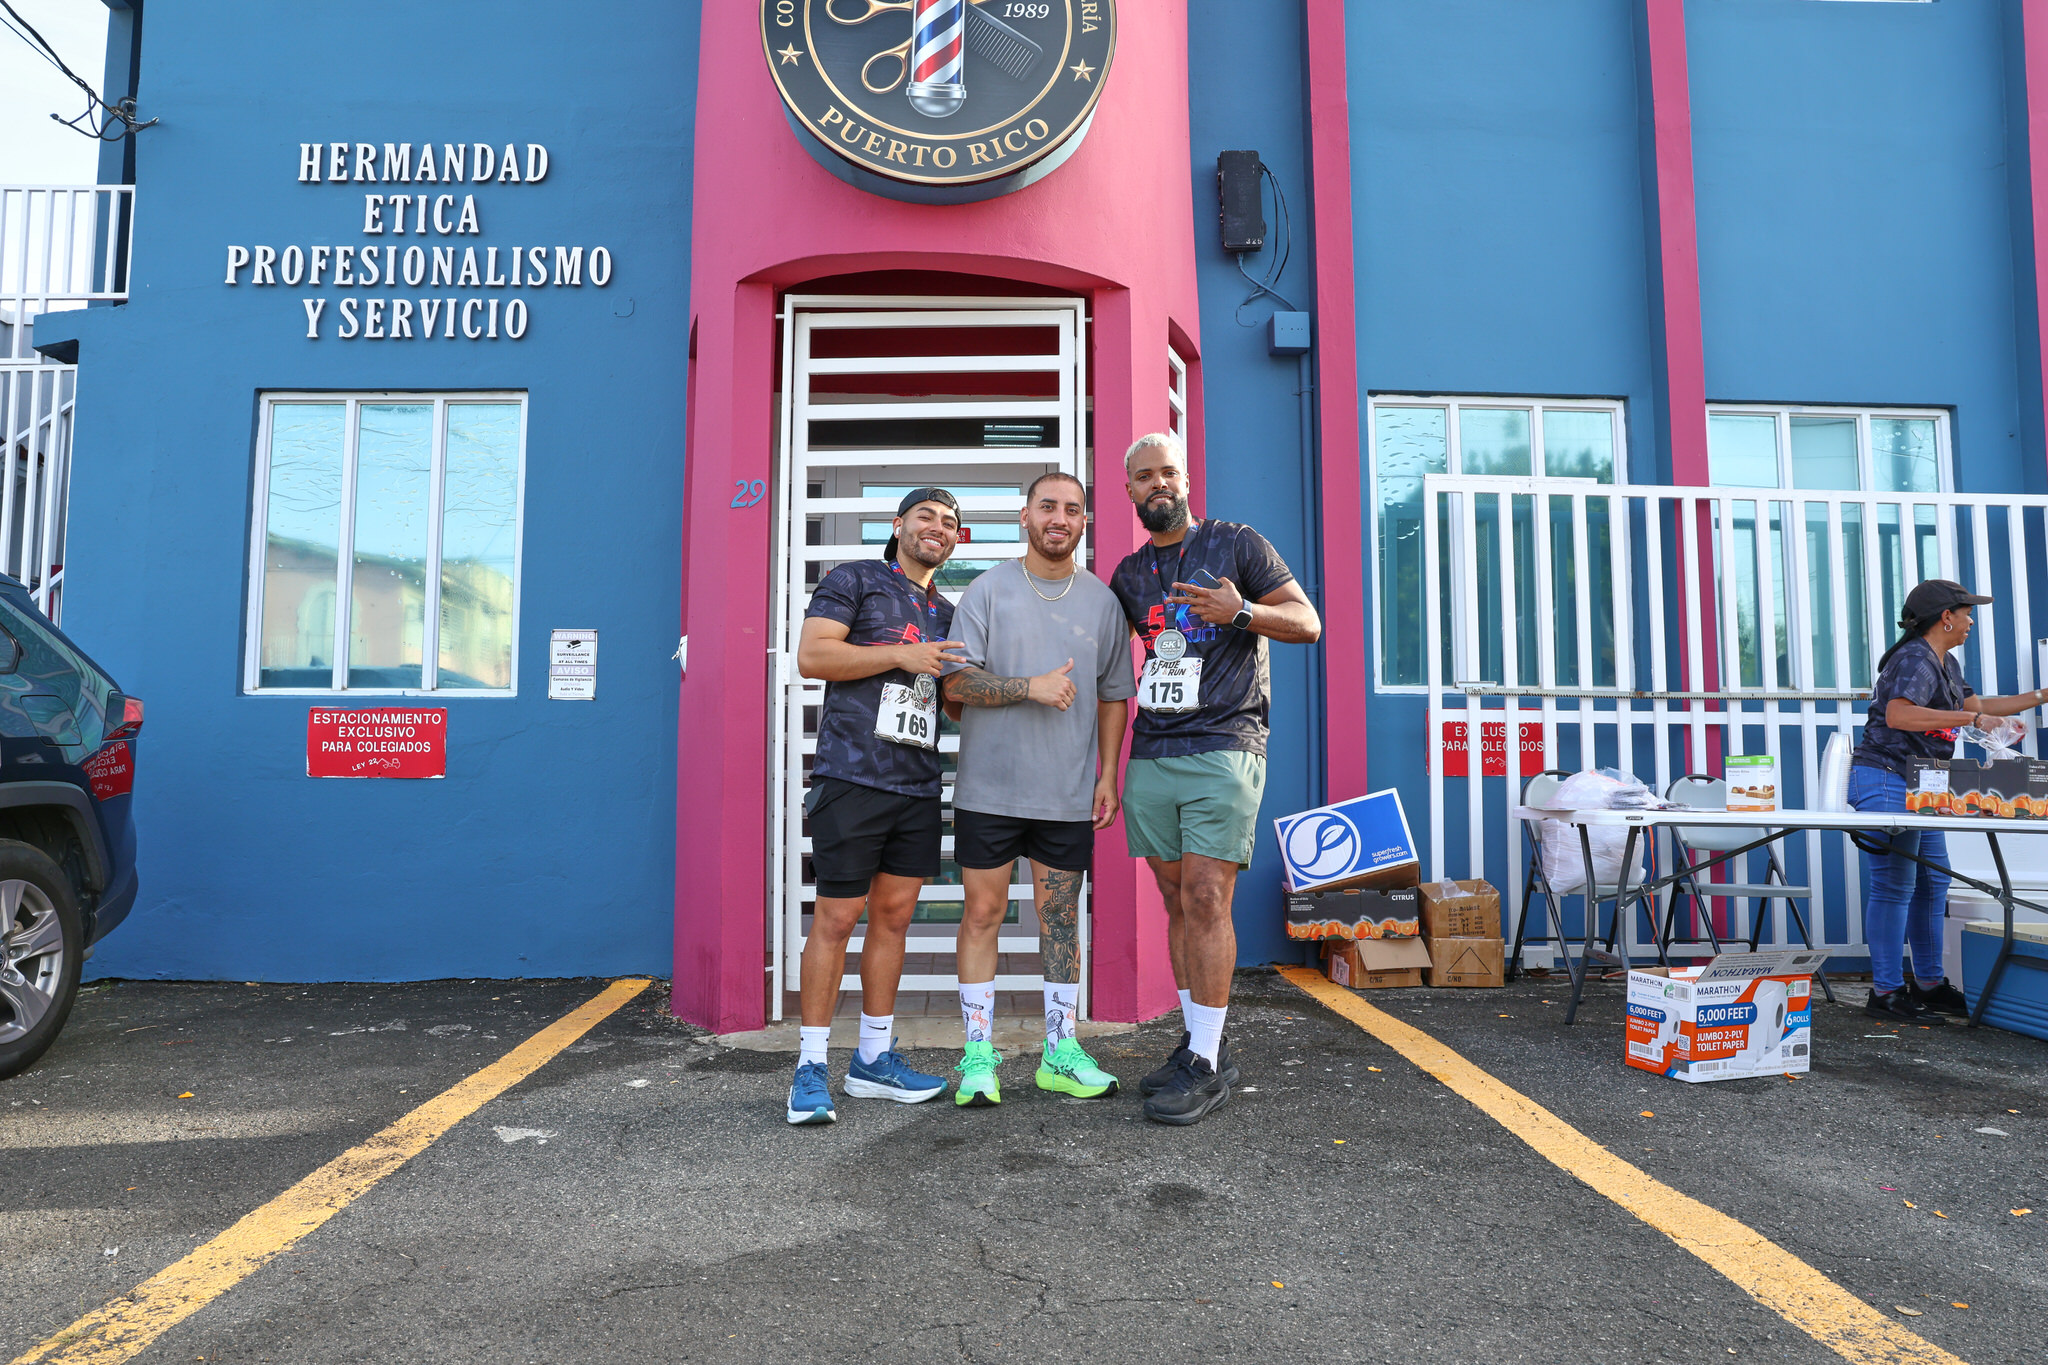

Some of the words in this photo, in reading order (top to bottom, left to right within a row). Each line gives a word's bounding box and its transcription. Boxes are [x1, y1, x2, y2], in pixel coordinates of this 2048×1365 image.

[1003, 2, 1050, 19] 1989
[817, 105, 957, 168] PUERTO
[967, 118, 1050, 166] RICO
[298, 142, 549, 182] HERMANDAD
[363, 194, 480, 234] ETICA
[224, 245, 612, 286] PROFESIONALISMO
[303, 298, 326, 338] Y
[338, 298, 528, 339] SERVICIO
[730, 478, 767, 509] 29
[553, 632, 595, 640] WARNING
[556, 667, 589, 675] AVISO
[1159, 661, 1182, 669] FADE
[1168, 668, 1187, 677] RUN
[1149, 682, 1184, 704] 175
[313, 713, 442, 724] ESTACIONAMIENTO
[896, 711, 928, 739] 169
[338, 726, 416, 738] EXCLUSIVO
[321, 741, 352, 753] PARA
[357, 741, 431, 753] COLEGIADOS
[351, 761, 366, 772] LEY
[368, 757, 377, 766] 22
[1373, 851, 1408, 864] growers.com
[1709, 966, 1775, 978] MARATHON
[1630, 975, 1663, 988] MARATHON
[1696, 985, 1741, 996] MARATHON
[1629, 1005, 1647, 1016] 6,000
[1698, 1008, 1726, 1024] 6,000
[1629, 1018, 1644, 1026] JUMBO
[1786, 1014, 1793, 1026] 6
[1793, 1015, 1809, 1023] ROLLS
[1629, 1024, 1643, 1032] TOILET
[1643, 1027, 1656, 1035] PAPER
[1697, 1032, 1723, 1042] JUMBO
[1725, 1030, 1744, 1040] 2-PLY
[1697, 1041, 1720, 1051] TOILET
[1722, 1040, 1745, 1050] PAPER
